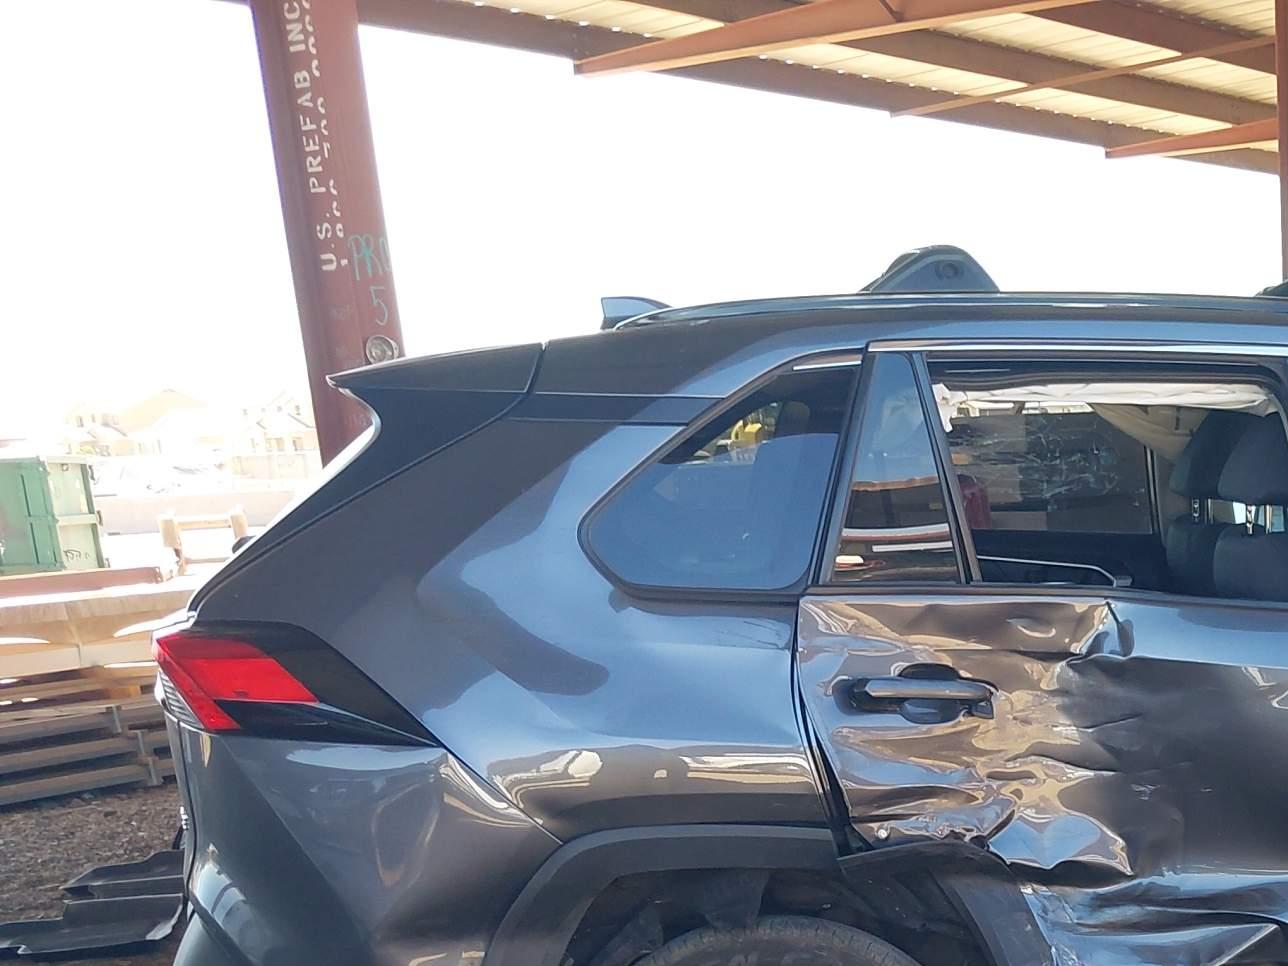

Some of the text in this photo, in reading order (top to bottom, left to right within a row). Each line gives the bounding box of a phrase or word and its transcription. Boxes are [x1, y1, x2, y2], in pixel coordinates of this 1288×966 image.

[293, 70, 327, 194] PREFAB
[316, 212, 338, 272] U.S.
[369, 285, 389, 326] 5
